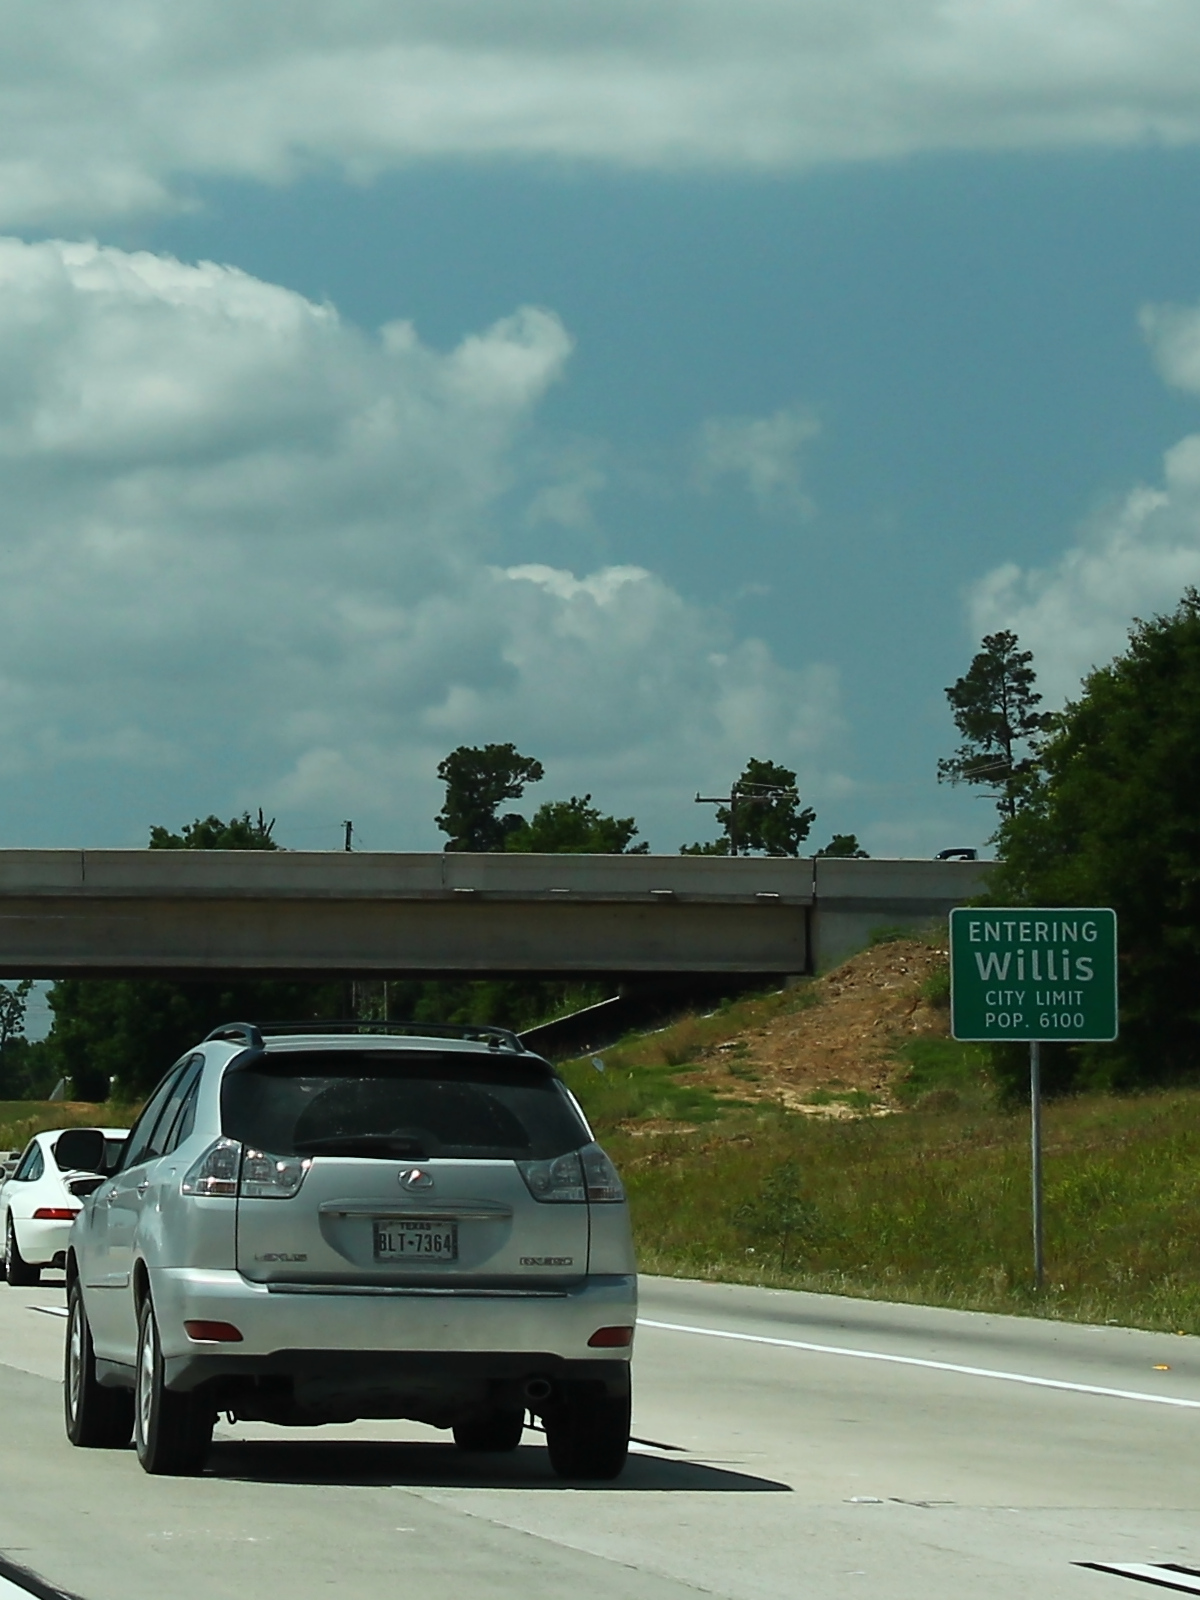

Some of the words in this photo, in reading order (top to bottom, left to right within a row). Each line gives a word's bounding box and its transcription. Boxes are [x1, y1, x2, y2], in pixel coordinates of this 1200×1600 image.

[969, 921, 1098, 942] ENTERING
[974, 948, 1095, 981] Willis
[985, 990, 1026, 1006] CITY
[1036, 990, 1084, 1006] LIMIT
[985, 1012, 1029, 1028] POP.
[1039, 1012, 1085, 1028] 6100
[400, 1222, 432, 1230] TEXAS
